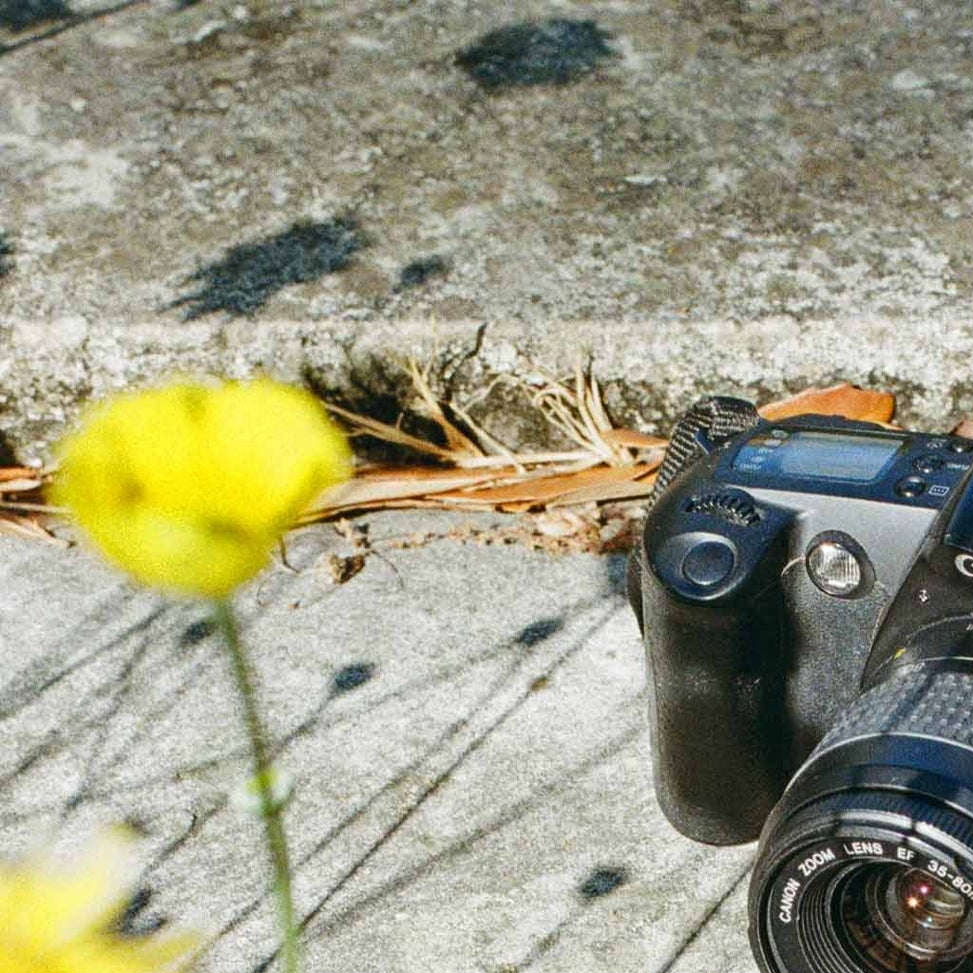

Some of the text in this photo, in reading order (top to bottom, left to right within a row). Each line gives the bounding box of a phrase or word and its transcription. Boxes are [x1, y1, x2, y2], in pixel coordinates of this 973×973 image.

[778, 878, 801, 924] CANON
[797, 847, 835, 878] ZOOM
[843, 841, 884, 856] LENS
[896, 847, 916, 861] EF
